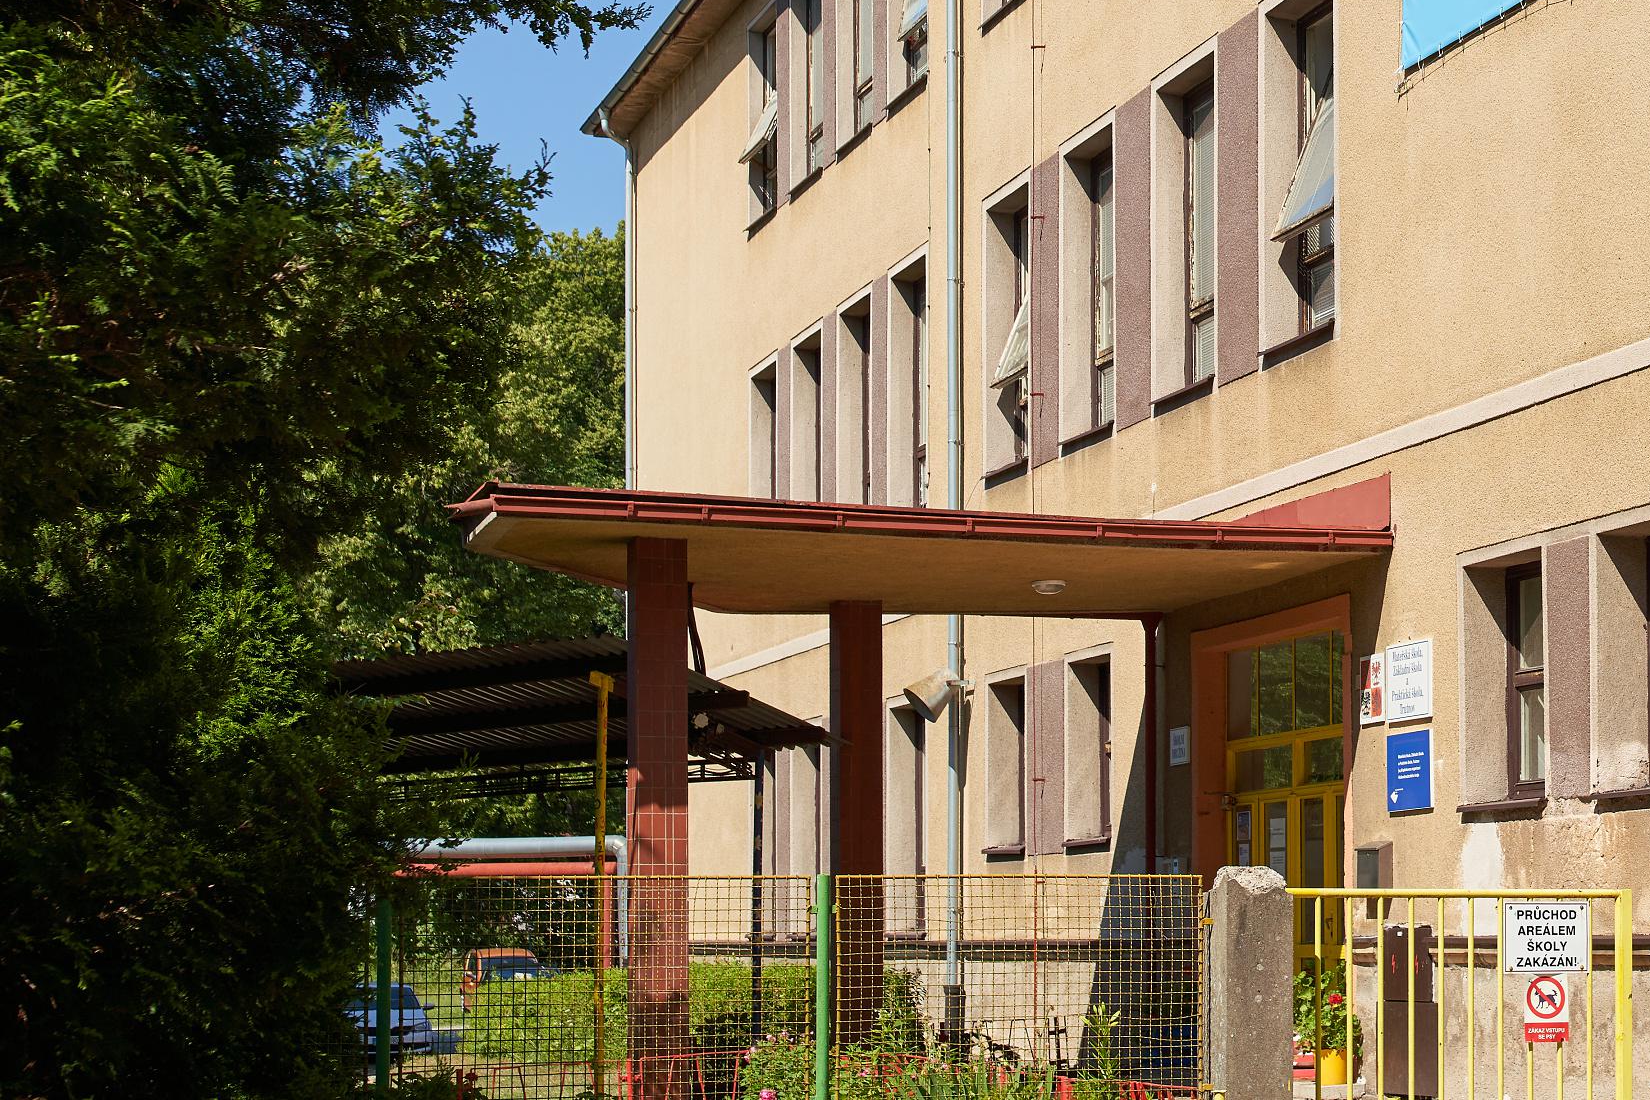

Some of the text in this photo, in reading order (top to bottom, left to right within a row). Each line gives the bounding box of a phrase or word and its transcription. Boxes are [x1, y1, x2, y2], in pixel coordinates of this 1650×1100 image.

[1516, 905, 1577, 920] PRŮCHOD
[1517, 922, 1576, 936] AREÁLEM
[1526, 939, 1568, 952] ŠKOLY
[1516, 954, 1577, 968] ZAKÁZÁN!
[1546, 1026, 1565, 1034] VSTUPU
